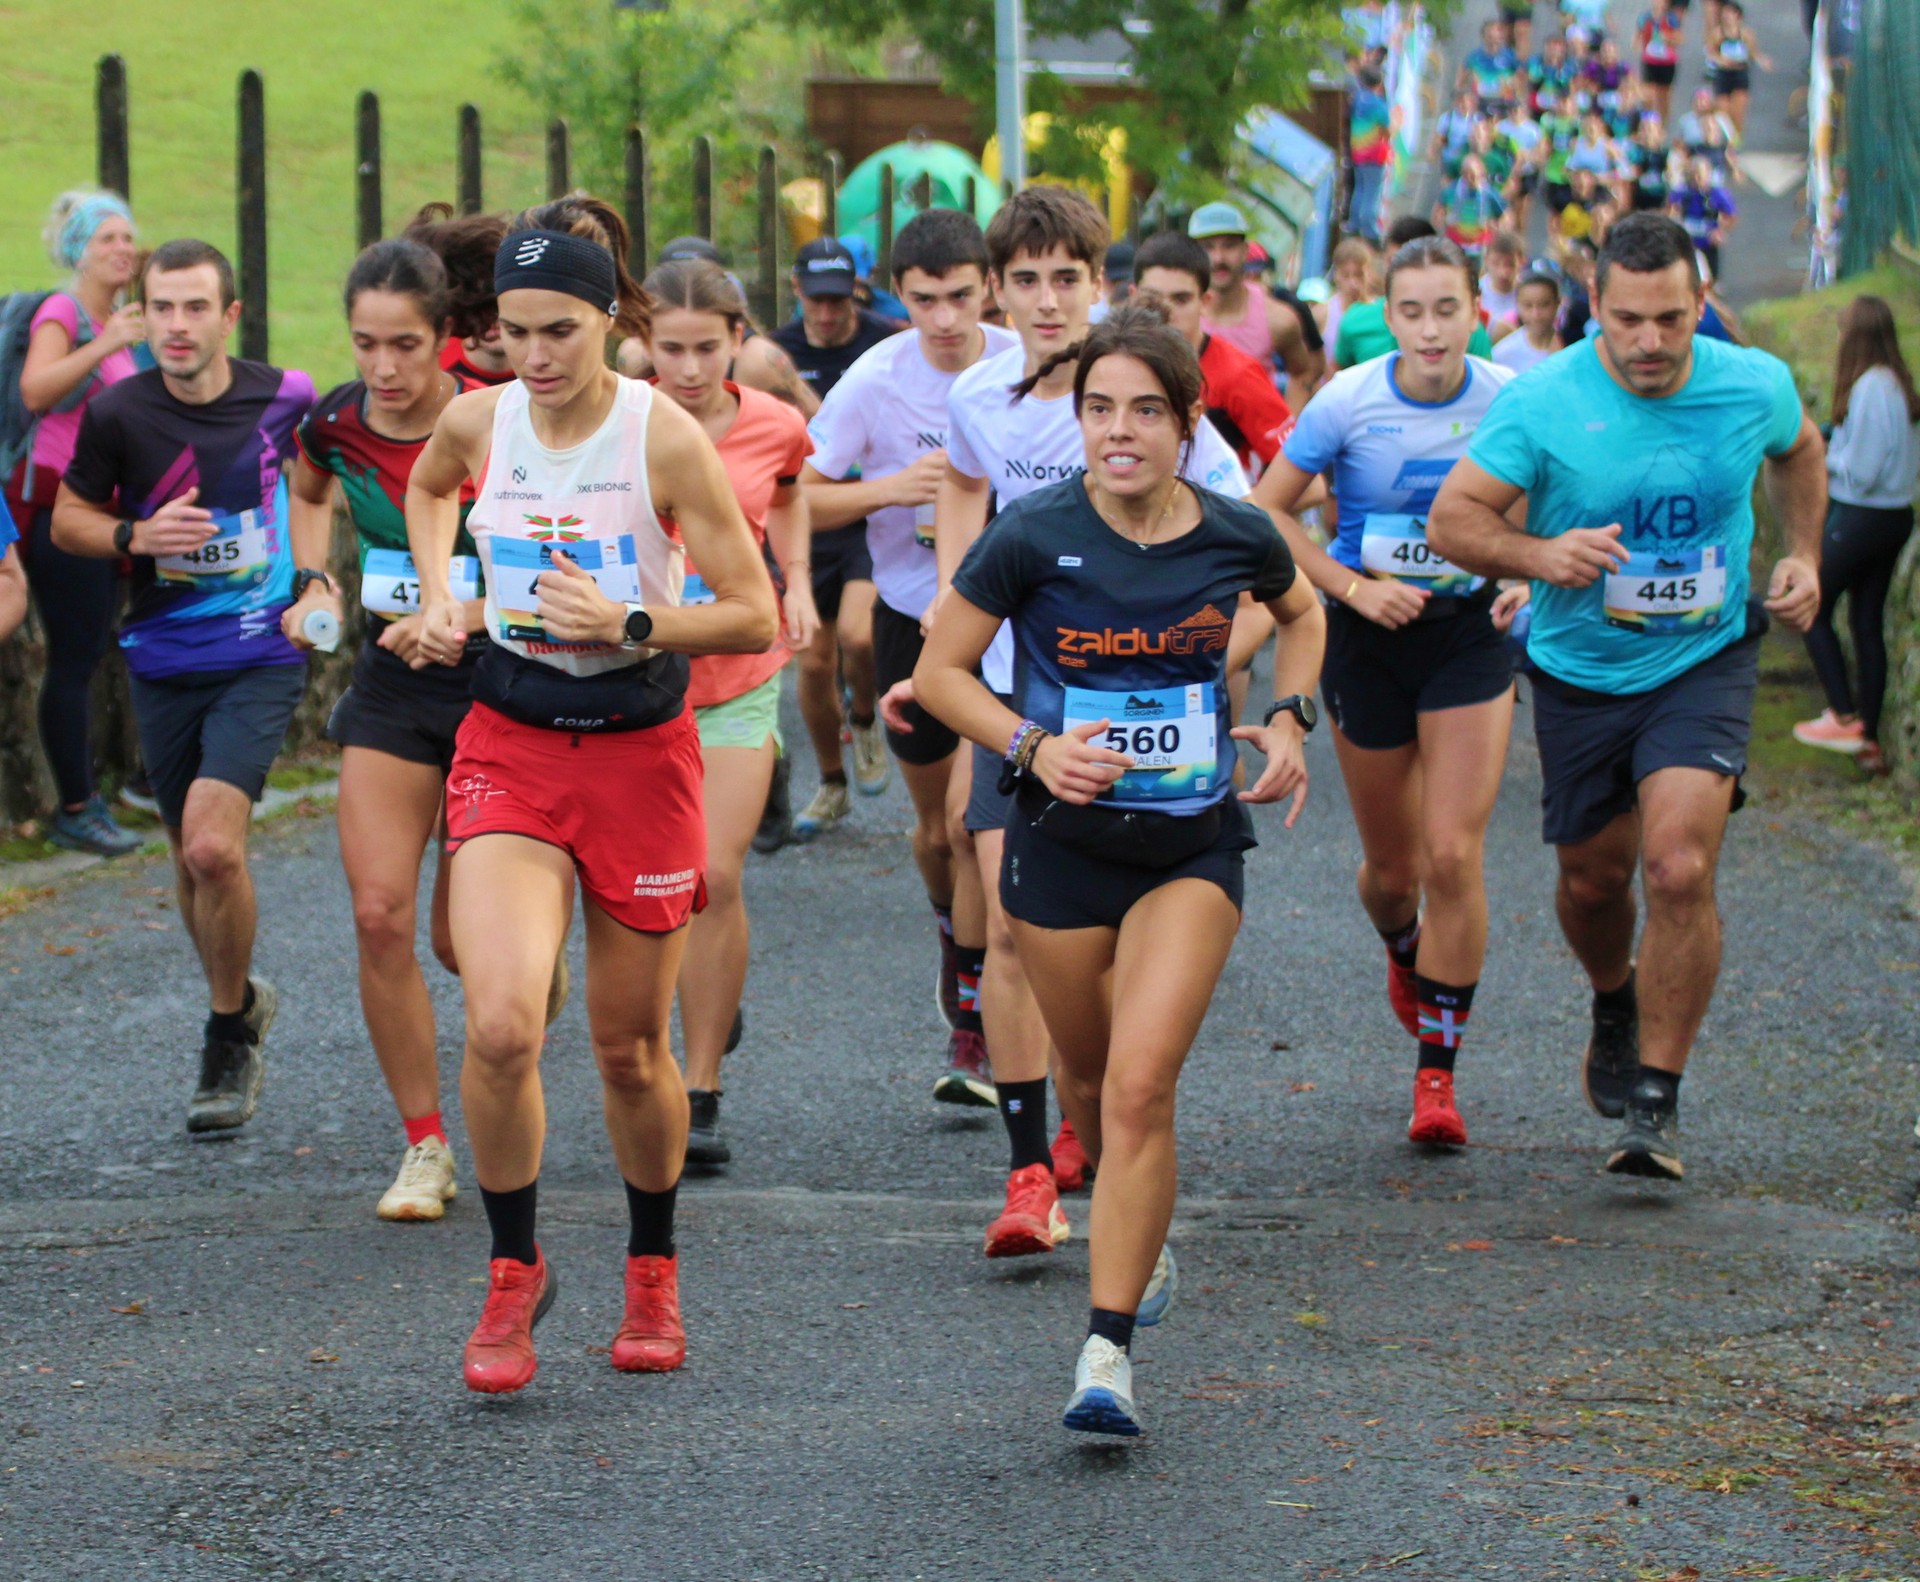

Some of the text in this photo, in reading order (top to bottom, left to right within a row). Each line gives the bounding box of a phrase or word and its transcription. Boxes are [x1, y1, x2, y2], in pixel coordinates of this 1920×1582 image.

[1633, 494, 1699, 540] KB
[183, 540, 240, 563] 485
[1637, 578, 1697, 602] 445
[1057, 654, 1088, 668] 2025
[1105, 724, 1180, 755] 560
